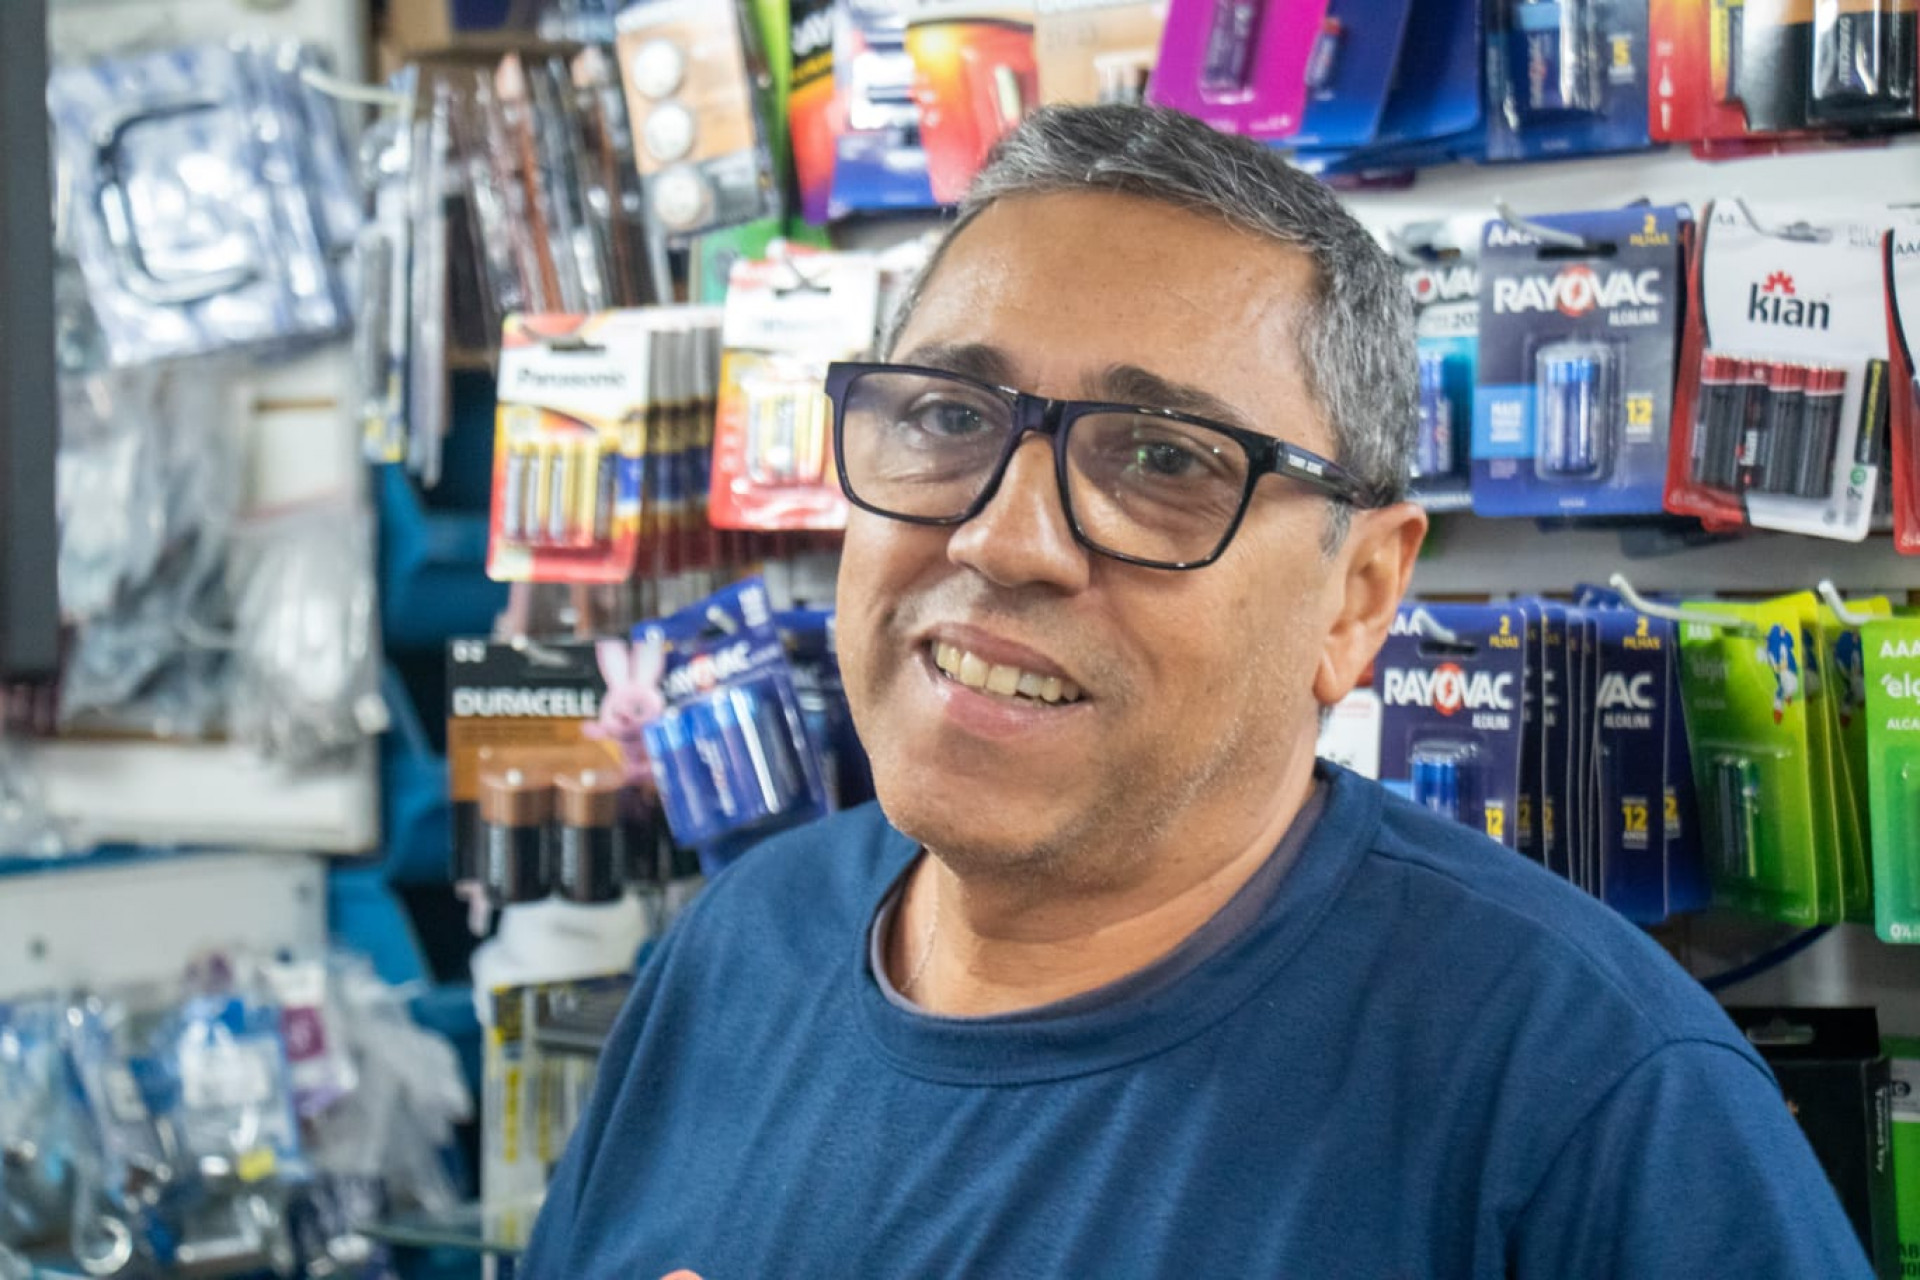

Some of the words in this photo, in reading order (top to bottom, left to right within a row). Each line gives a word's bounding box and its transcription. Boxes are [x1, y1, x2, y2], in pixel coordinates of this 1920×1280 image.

[1644, 213, 1656, 234] 2
[1493, 267, 1663, 315] RAYOVAC
[1608, 309, 1660, 326] ALCALINA
[1748, 280, 1831, 330] kian
[1626, 399, 1653, 425] 12
[1499, 611, 1511, 635] 2
[1636, 615, 1648, 636] 2
[453, 685, 598, 718] DURACELL
[1384, 668, 1514, 711] RAYOVAC
[1603, 712, 1650, 728] ALCALINA
[1485, 808, 1504, 835] 12
[1622, 805, 1648, 832] 12
